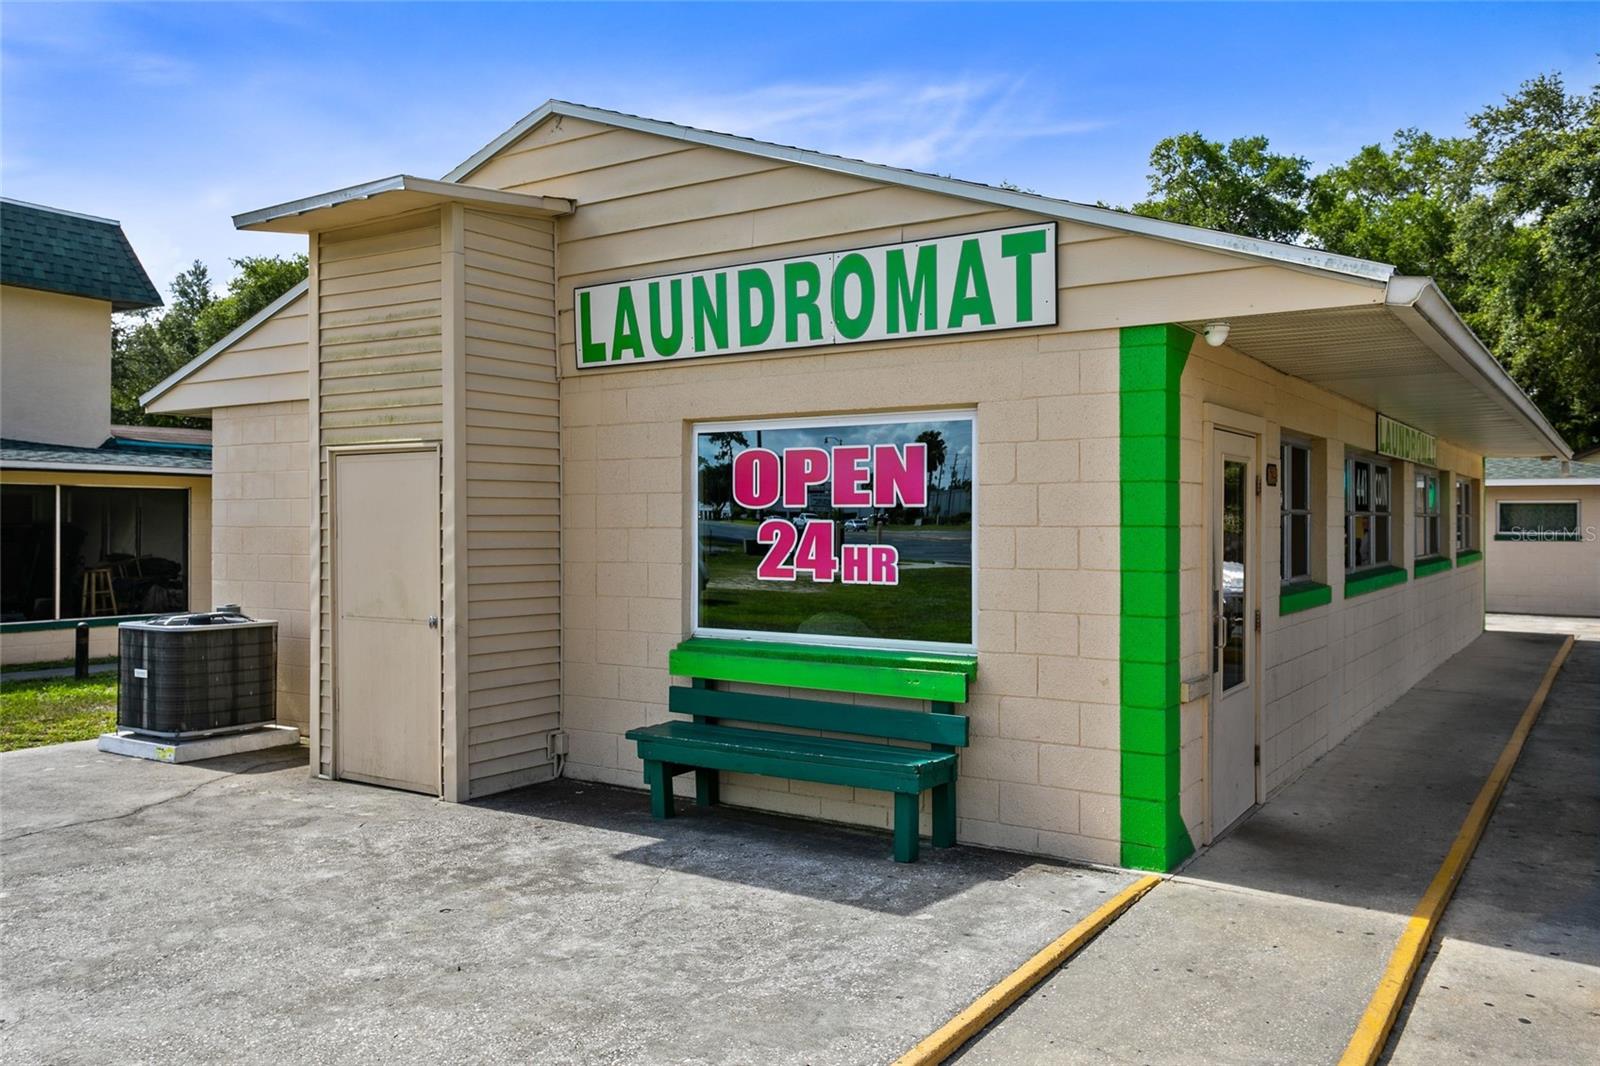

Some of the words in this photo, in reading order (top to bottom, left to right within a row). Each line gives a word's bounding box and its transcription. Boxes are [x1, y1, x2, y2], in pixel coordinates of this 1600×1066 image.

[579, 228, 1047, 364] LAUNDROMAT
[1379, 416, 1436, 466] LAUNDROMAT
[732, 443, 928, 510] OPEN
